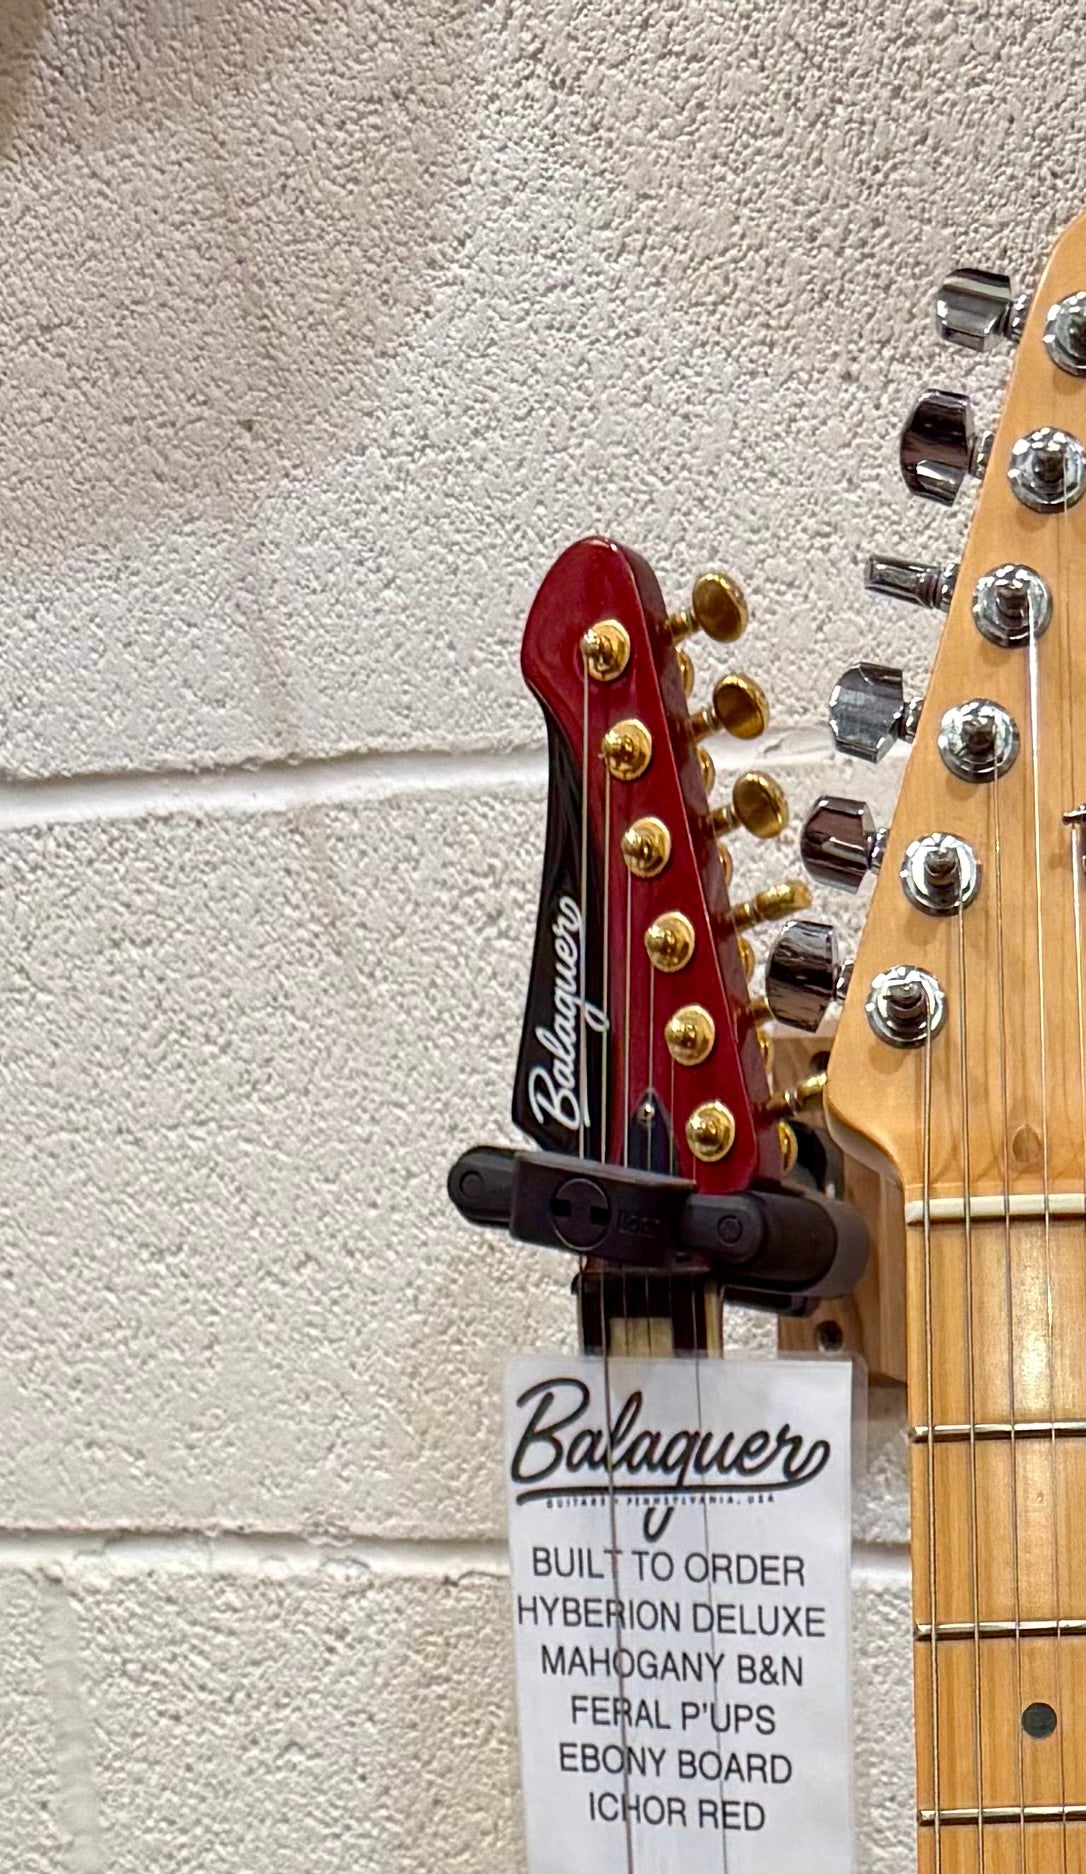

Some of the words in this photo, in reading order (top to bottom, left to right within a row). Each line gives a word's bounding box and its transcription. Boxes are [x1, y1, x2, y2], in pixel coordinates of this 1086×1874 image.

[527, 896, 610, 1130] Balaguer
[509, 1377, 832, 1544] Balaguer
[532, 1546, 623, 1580] BUILT
[631, 1550, 674, 1582] TO
[684, 1552, 805, 1587] ORDER
[517, 1595, 681, 1632] HYBERION
[693, 1603, 826, 1638] DELUXE
[541, 1644, 725, 1683] MAHOGANY
[737, 1654, 803, 1687] B&N
[570, 1695, 671, 1730] FERAL
[682, 1701, 776, 1736] P'UPS
[559, 1742, 666, 1777] EBONY
[678, 1749, 793, 1785] BOARD
[589, 1791, 687, 1827] ICHOR
[699, 1799, 766, 1832] RED
